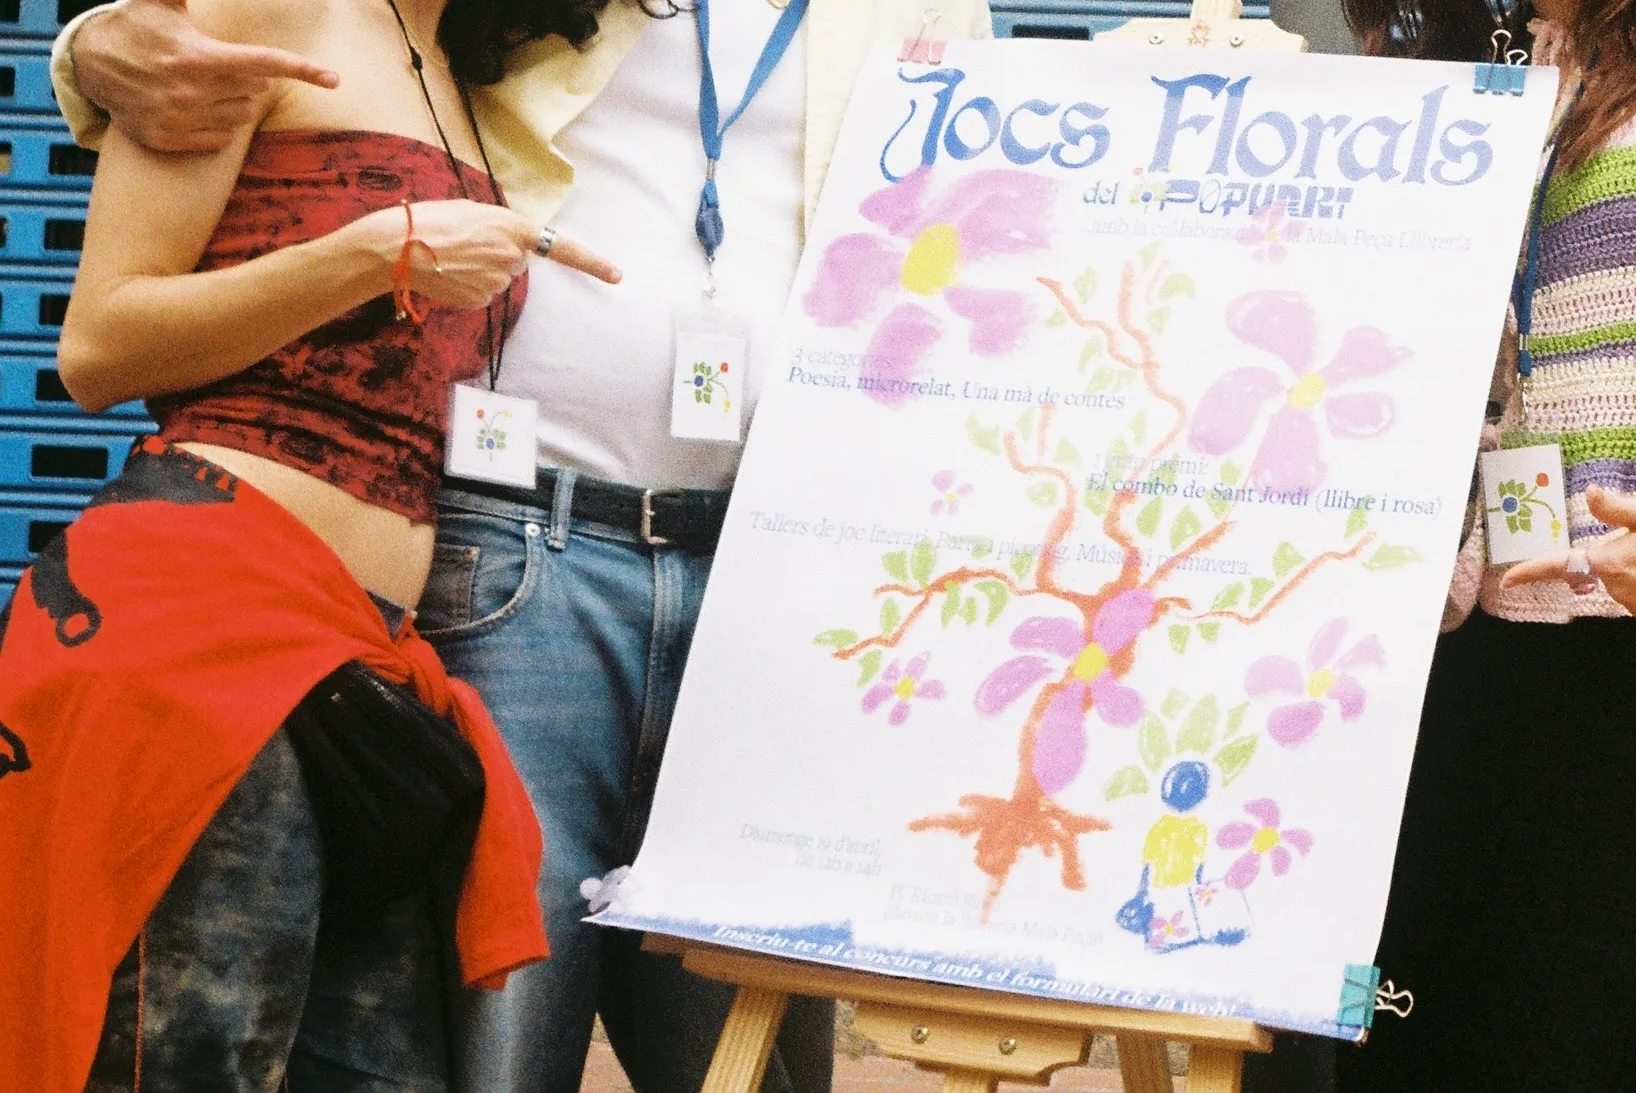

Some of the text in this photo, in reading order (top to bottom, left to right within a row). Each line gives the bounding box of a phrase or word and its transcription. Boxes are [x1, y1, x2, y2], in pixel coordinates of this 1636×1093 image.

[879, 66, 1495, 187] Jocs Florals
[1082, 180, 1120, 205] del
[787, 365, 851, 392] Poesia,
[963, 380, 999, 401] Una
[1003, 382, 1034, 404] mà
[1037, 385, 1060, 406] de
[1063, 390, 1126, 411] contes
[1088, 470, 1443, 520] El combo de Sant Jordi (llibre i rosa)
[749, 510, 809, 536] Tallers
[813, 517, 835, 539] de
[835, 520, 864, 545] joc
[819, 941, 844, 958] al
[932, 960, 984, 980] amb
[986, 966, 1008, 984] el
